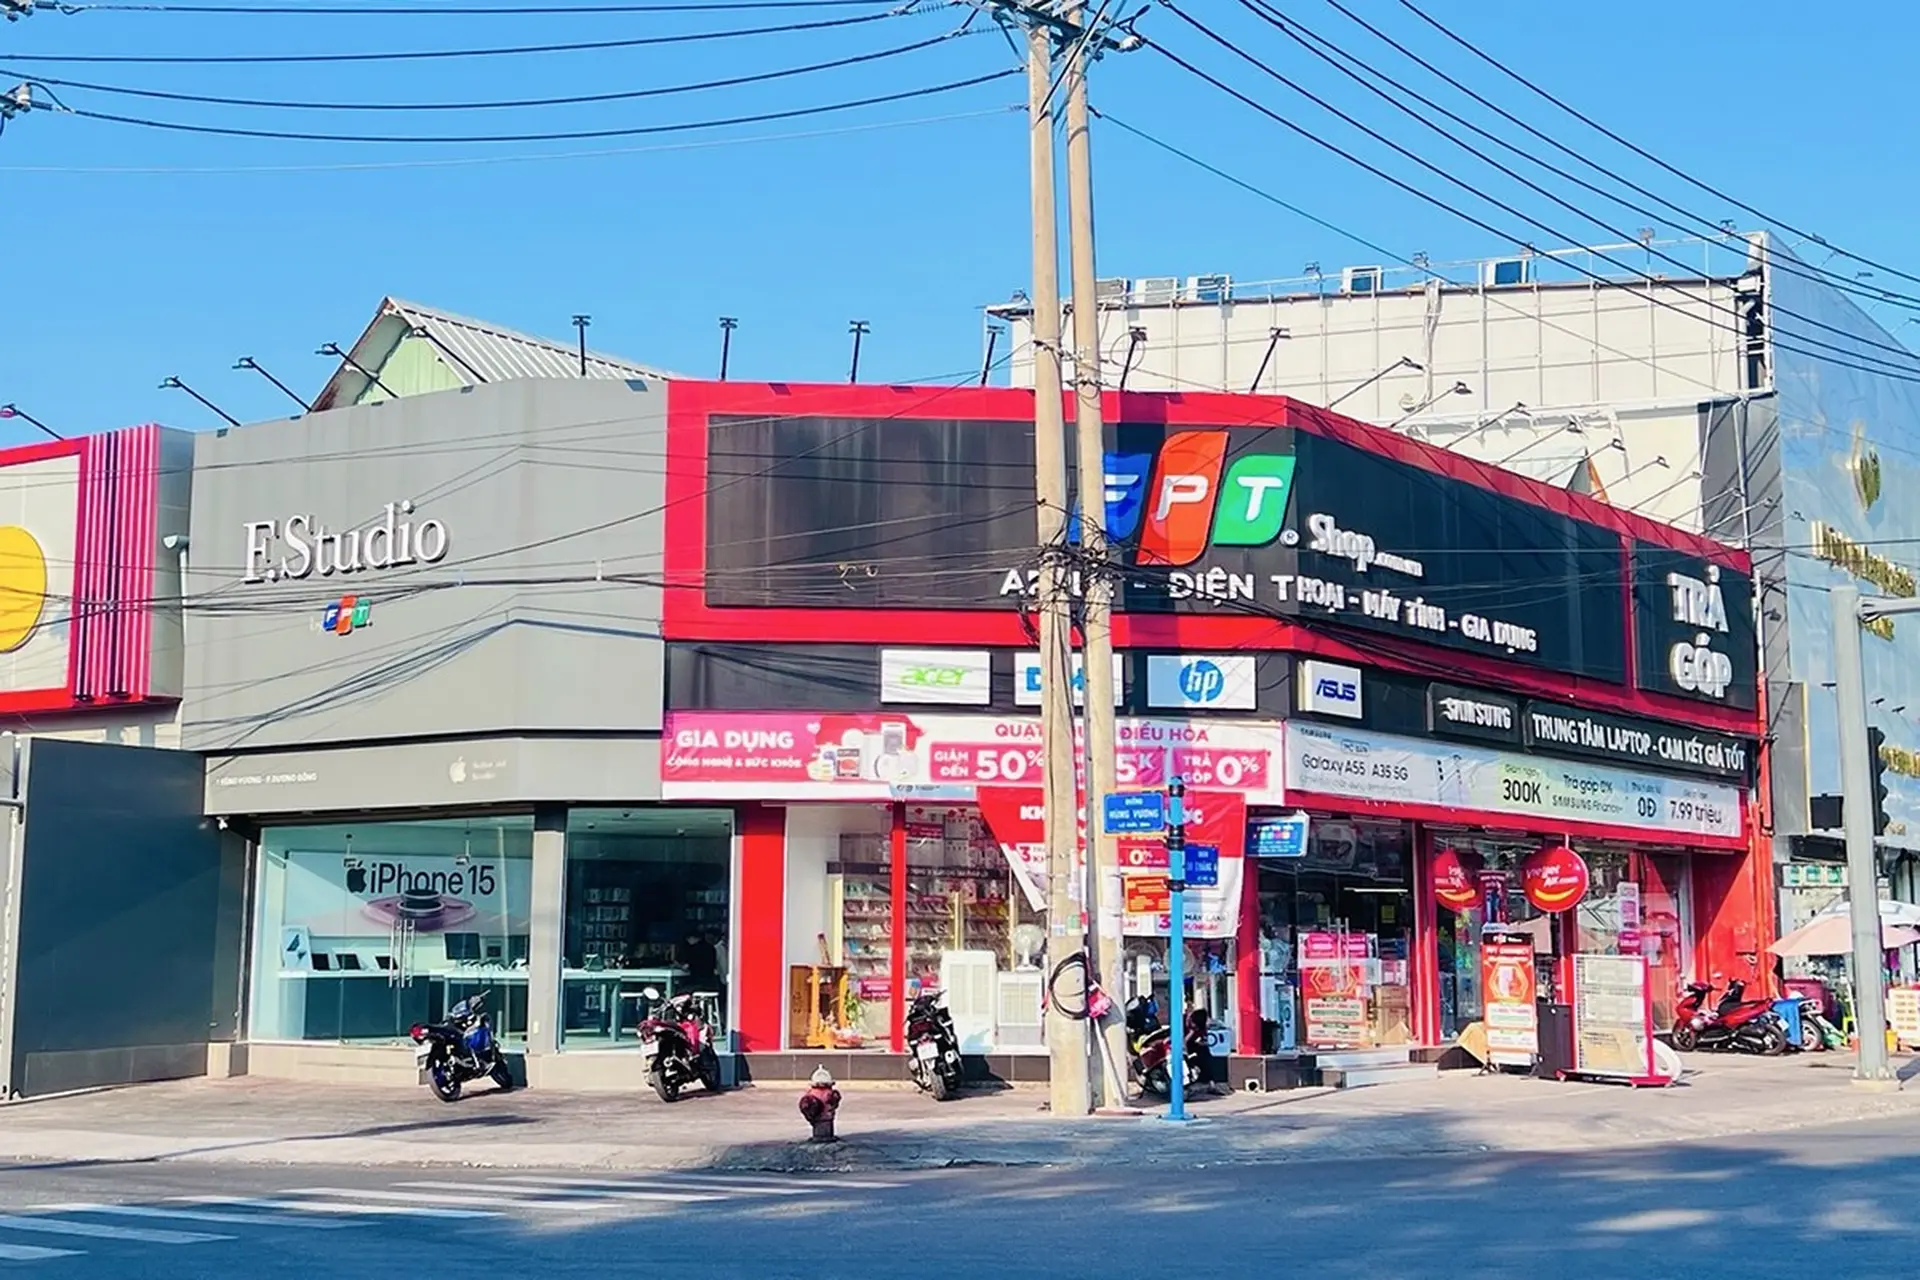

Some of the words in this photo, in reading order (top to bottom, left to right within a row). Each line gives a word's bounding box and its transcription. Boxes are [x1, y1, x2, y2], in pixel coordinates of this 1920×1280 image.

[240, 500, 448, 584] F.Studio
[1168, 566, 1254, 606] ĐIỆN
[1362, 589, 1401, 621] MÁY
[1404, 596, 1446, 631] TÍNH
[1461, 613, 1492, 642] GIA
[1493, 620, 1537, 654] DỤNG
[1667, 565, 1730, 633] TRẢ
[900, 666, 970, 686] acer
[1669, 632, 1733, 698] GÓP
[1184, 661, 1219, 702] hp
[1316, 678, 1356, 702] ASUS
[1439, 697, 1512, 730] SAMSUNG
[676, 730, 719, 748] GIA
[724, 731, 794, 752] DỤNG
[1532, 712, 1577, 744] TRUNG
[1578, 718, 1606, 748] TÂM
[1608, 726, 1651, 756] LAPTOP
[1658, 736, 1684, 761] CAM
[934, 748, 969, 763] GIẢM
[975, 750, 1044, 780] 50%
[1183, 751, 1213, 767] TRẢ
[1302, 753, 1344, 776] Galaxy
[1345, 760, 1366, 776] A55
[1372, 764, 1392, 779] A35
[1394, 766, 1409, 781] 5G
[940, 763, 969, 777] ĐẾN
[1181, 769, 1213, 784] GÓP
[1216, 755, 1260, 786] 0%
[1503, 778, 1542, 805] 300K
[1580, 780, 1599, 795] góp
[1637, 796, 1657, 818] 0Đ
[1670, 800, 1693, 821] 7.99
[1694, 802, 1723, 829] triệu
[370, 862, 464, 895] iPhone
[467, 865, 495, 896] 15
